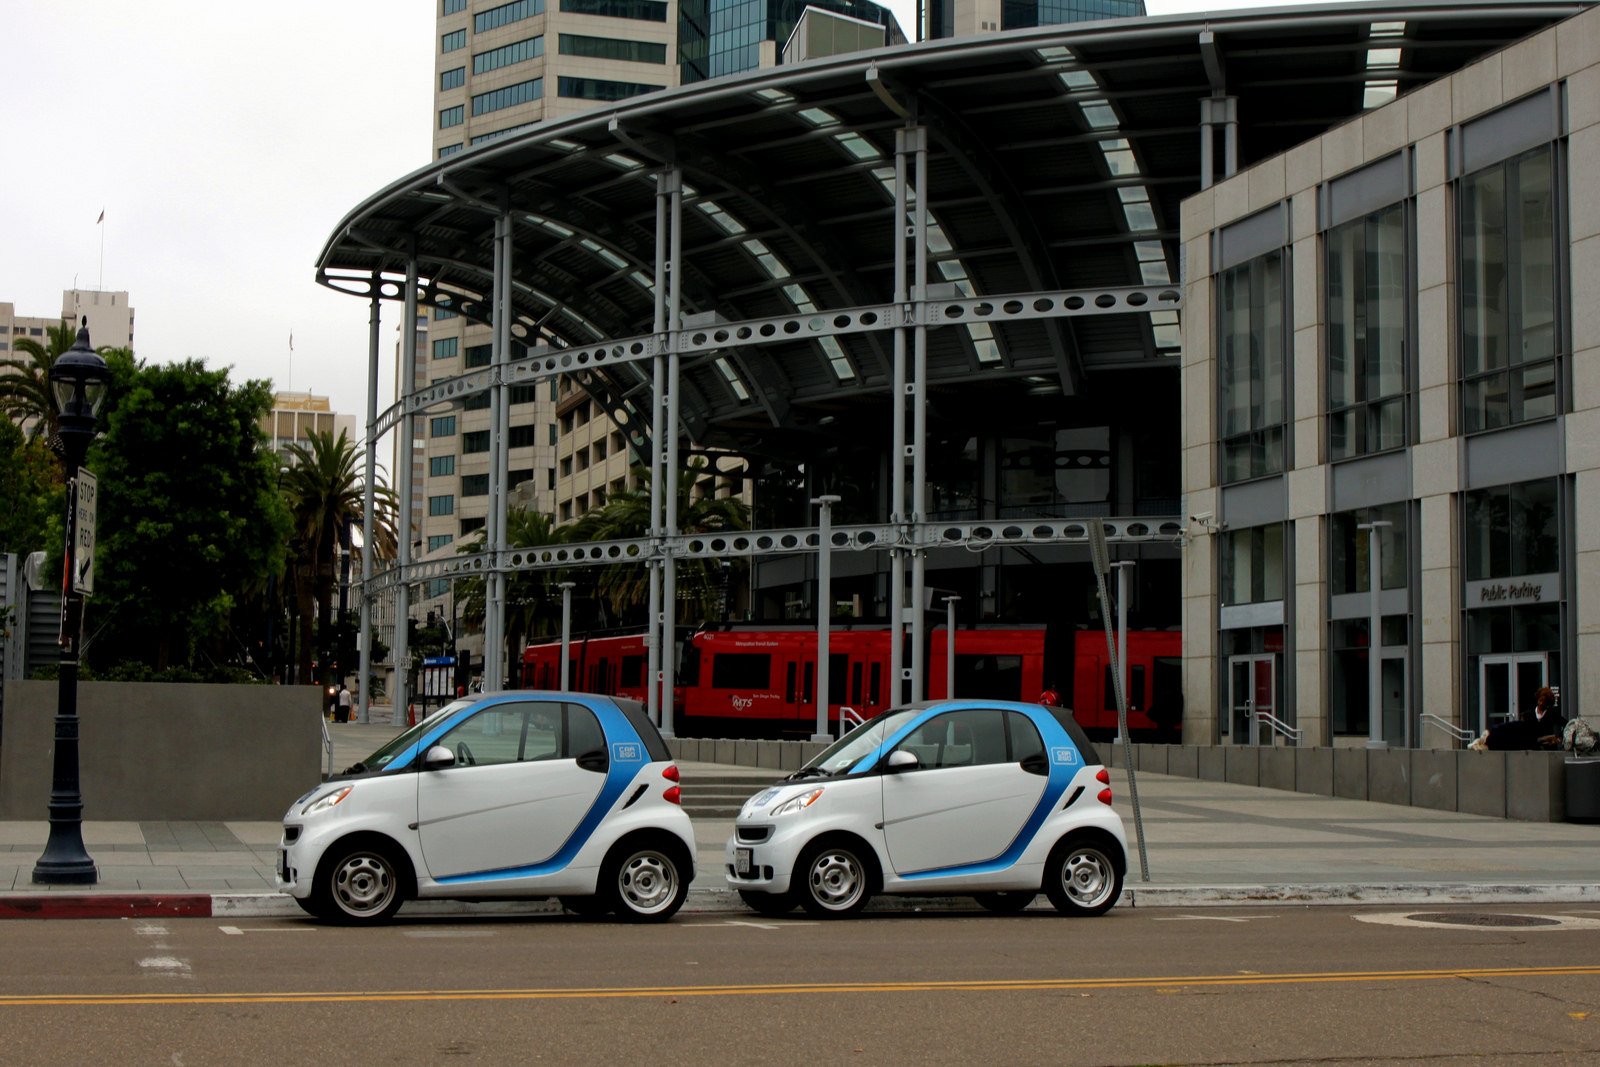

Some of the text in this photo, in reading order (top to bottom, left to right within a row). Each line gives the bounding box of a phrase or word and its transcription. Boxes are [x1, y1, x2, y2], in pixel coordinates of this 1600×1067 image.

[79, 482, 95, 504] STOP
[79, 528, 91, 548] RED
[1481, 581, 1542, 601] Public Parking
[732, 698, 753, 707] MTS
